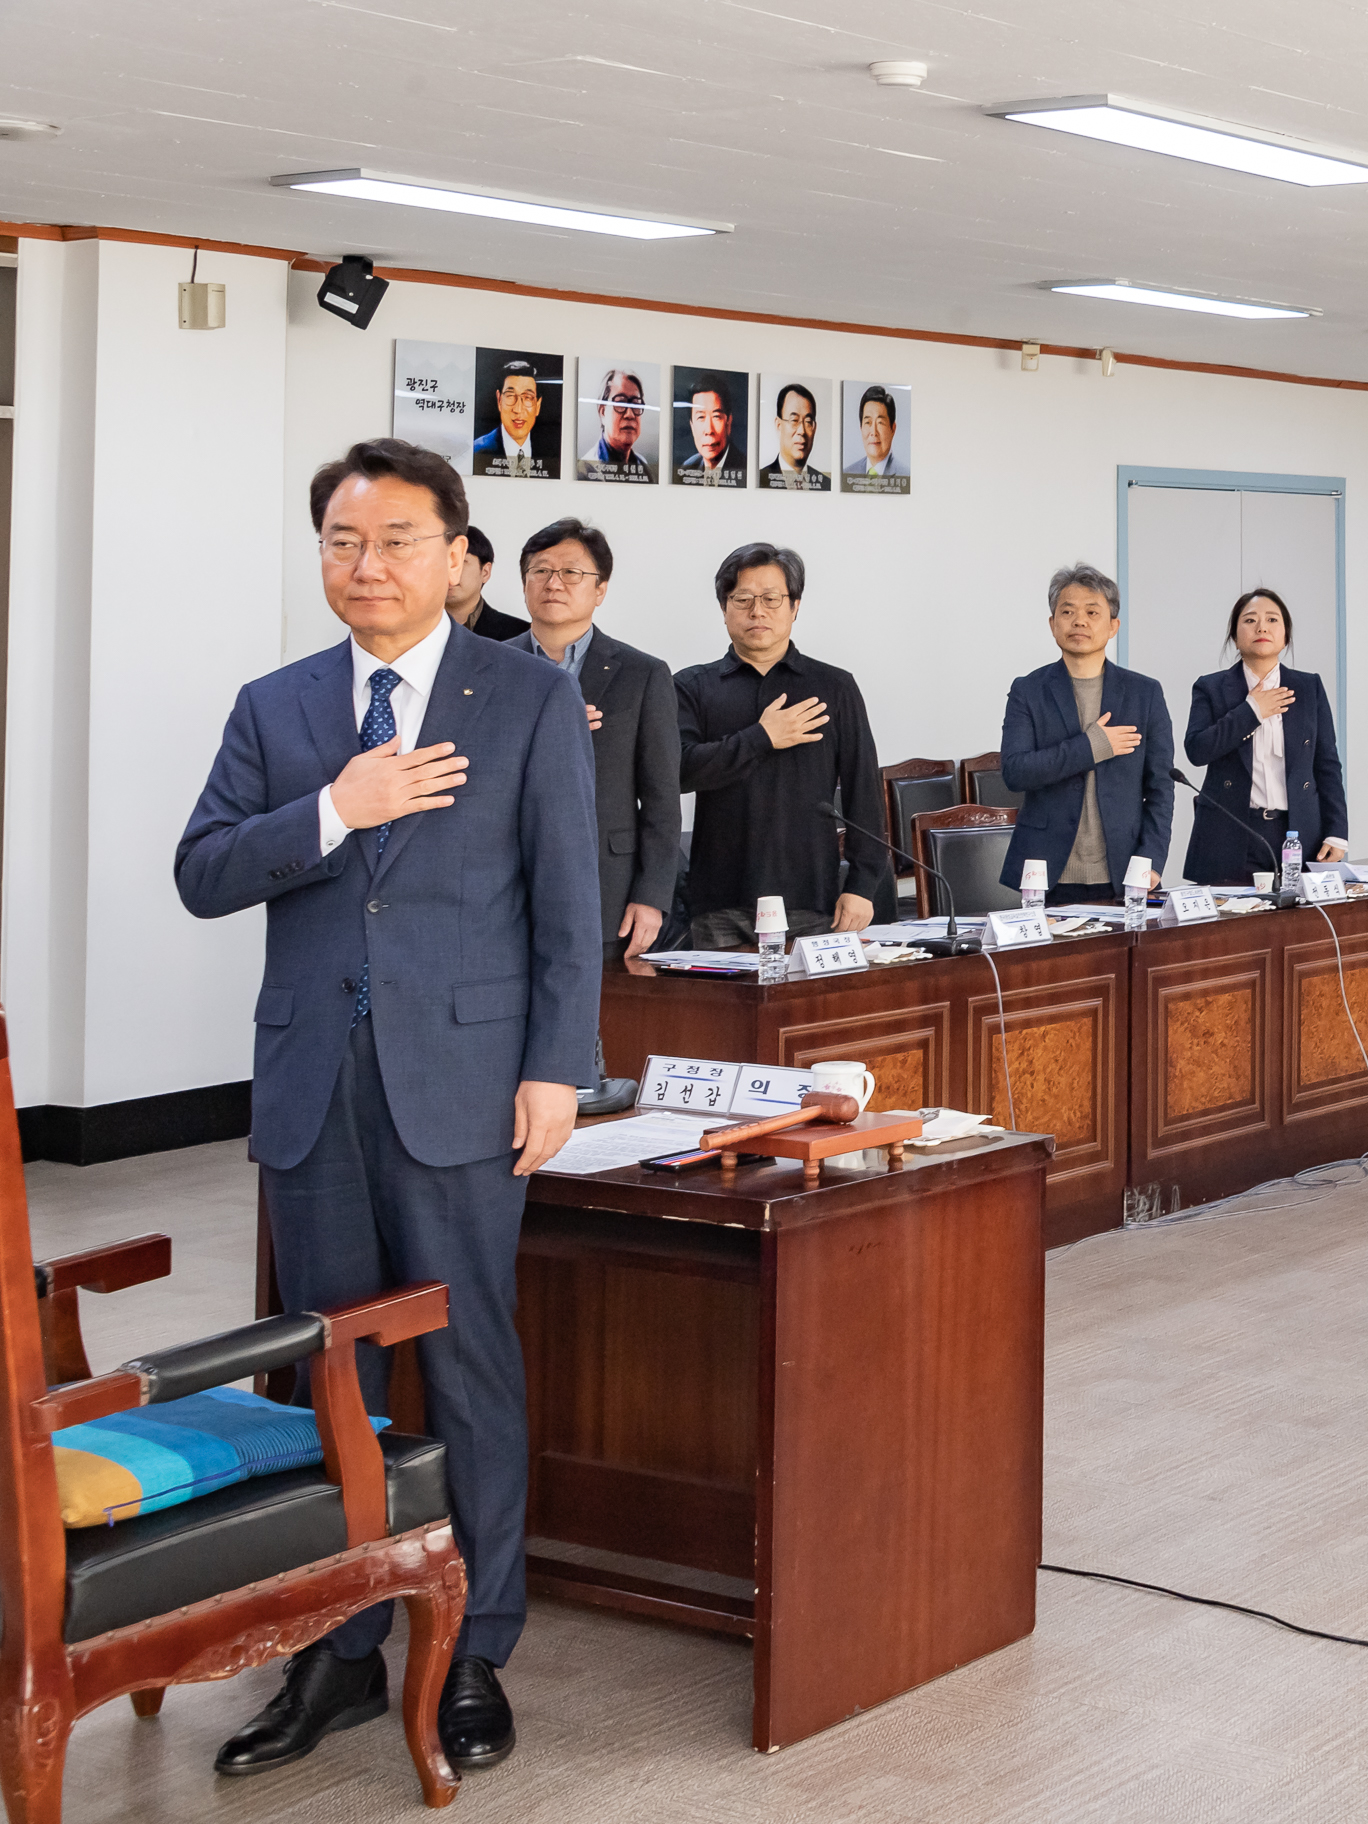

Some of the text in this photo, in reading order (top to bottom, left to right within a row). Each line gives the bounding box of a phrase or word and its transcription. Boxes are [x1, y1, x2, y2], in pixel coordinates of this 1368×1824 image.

[405, 377, 439, 393] 광진구
[415, 398, 467, 414] 역대구청장
[654, 1080, 721, 1107] 김선갑
